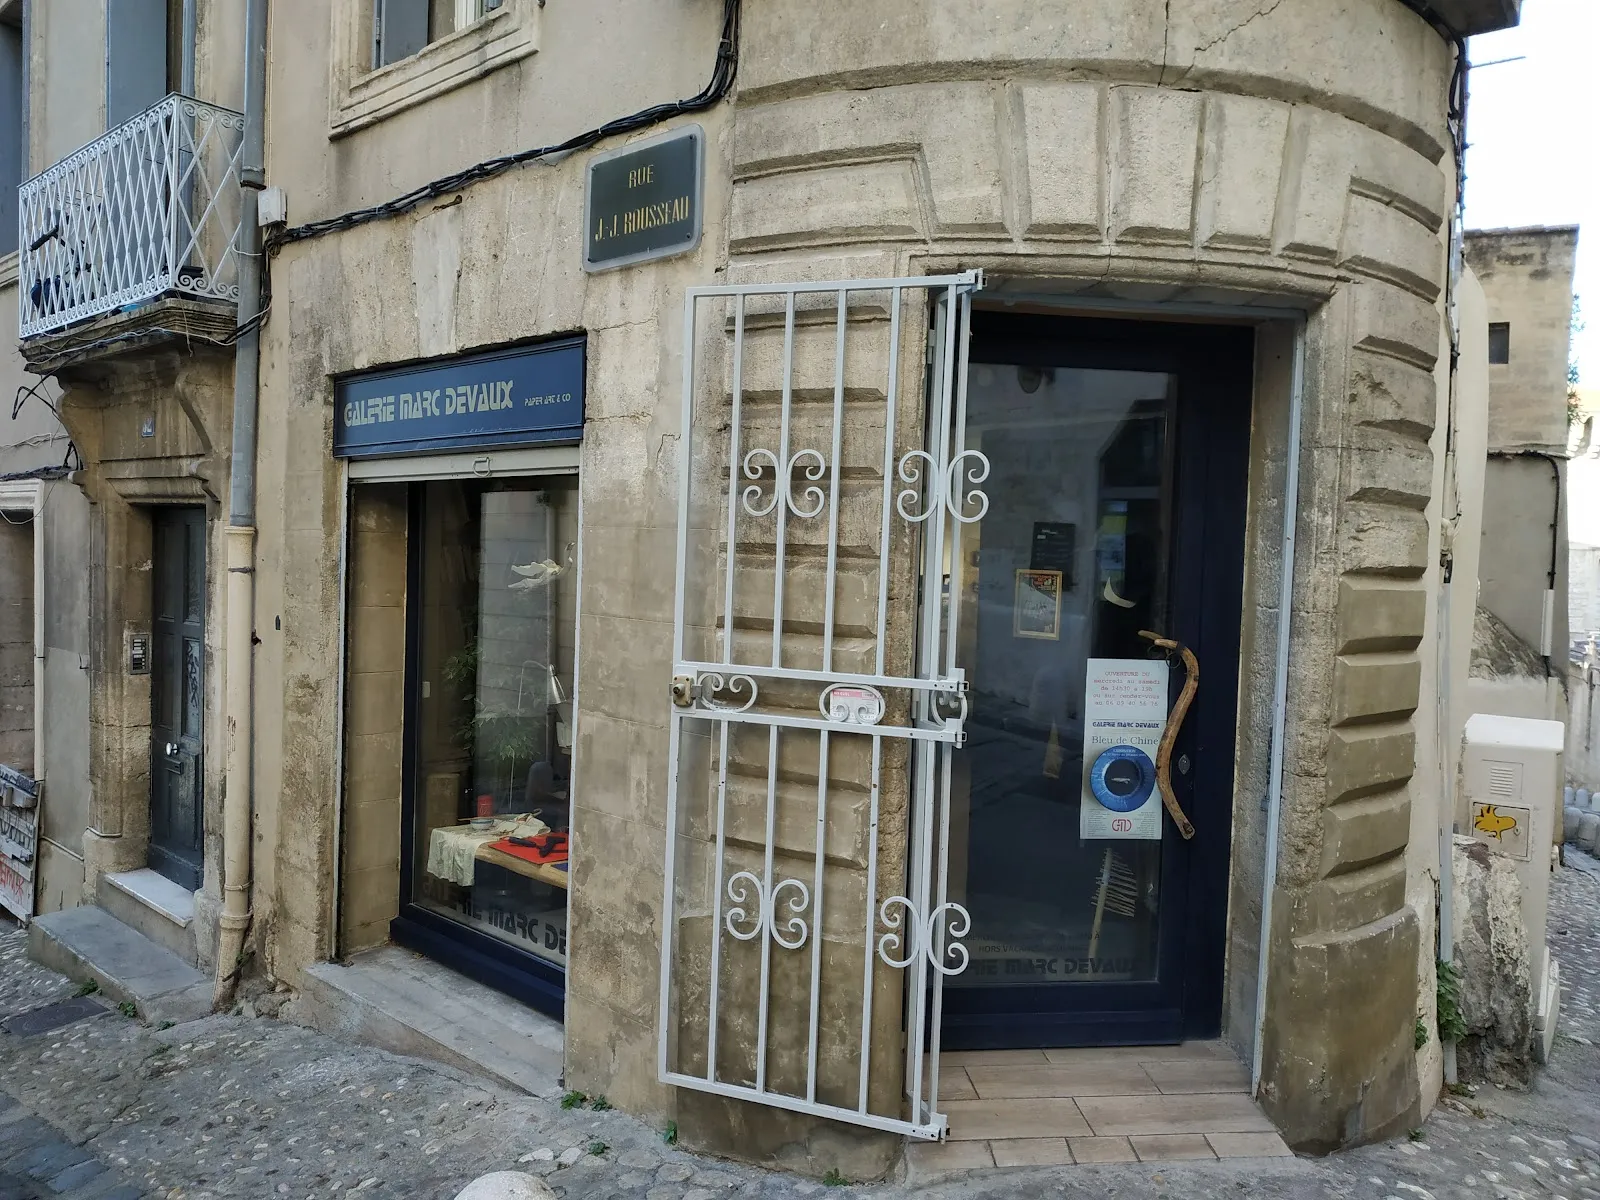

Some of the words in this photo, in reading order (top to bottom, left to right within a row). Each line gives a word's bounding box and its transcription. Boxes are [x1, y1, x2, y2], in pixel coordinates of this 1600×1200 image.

[628, 164, 655, 189] RUE
[623, 195, 690, 236] ROUSSEAU
[343, 394, 396, 428] GALERIE
[399, 388, 441, 421] MARC
[445, 379, 514, 416] DEVAUX
[524, 396, 543, 407] PAPER
[561, 392, 572, 403] CO
[1091, 735, 1113, 745] Bleu
[1116, 736, 1127, 745] de
[1130, 736, 1159, 745] Chine
[488, 904, 539, 944] MARC
[978, 944, 1000, 954] HORS
[1004, 957, 1059, 976] MARC
